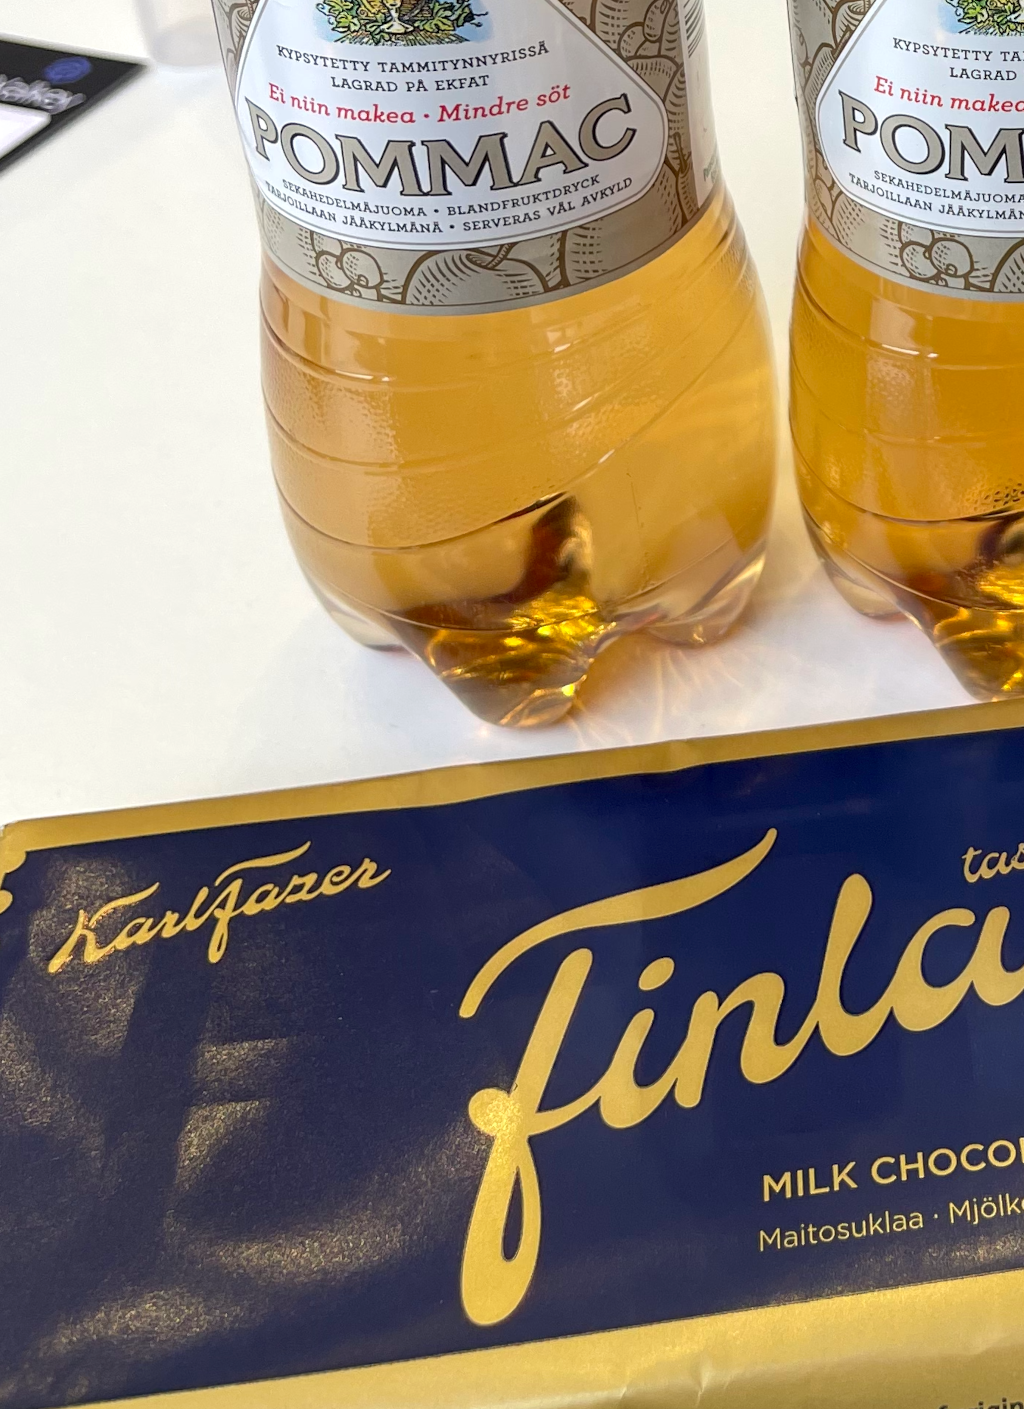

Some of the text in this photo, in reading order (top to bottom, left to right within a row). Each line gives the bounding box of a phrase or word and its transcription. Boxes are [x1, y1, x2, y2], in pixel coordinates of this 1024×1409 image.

[276, 41, 549, 73] KYPSYTETTY TAMMITYNNYRISSÄ
[893, 36, 993, 63] KYPSYTETTY
[330, 74, 490, 92] LAGRAD PÅ EKFAT
[874, 76, 894, 97] Ei
[899, 85, 944, 109] niin
[949, 67, 1017, 82] LAGRAD
[269, 82, 571, 124] Ei niin makea Mindre söt
[245, 92, 638, 197] POMMAC
[265, 180, 338, 224] TARJOILLAAN
[463, 210, 541, 232] SERVERAS
[547, 200, 576, 217] VÄL
[581, 177, 634, 208] AVKYLD
[282, 174, 600, 217] SEKAHEDELMÄJUOMA BLANDFRUKTDRYCK
[849, 172, 933, 211] TARJOILLAAN
[762, 1162, 858, 1202] MILK
[759, 1209, 924, 1252] Maitosuklaa
